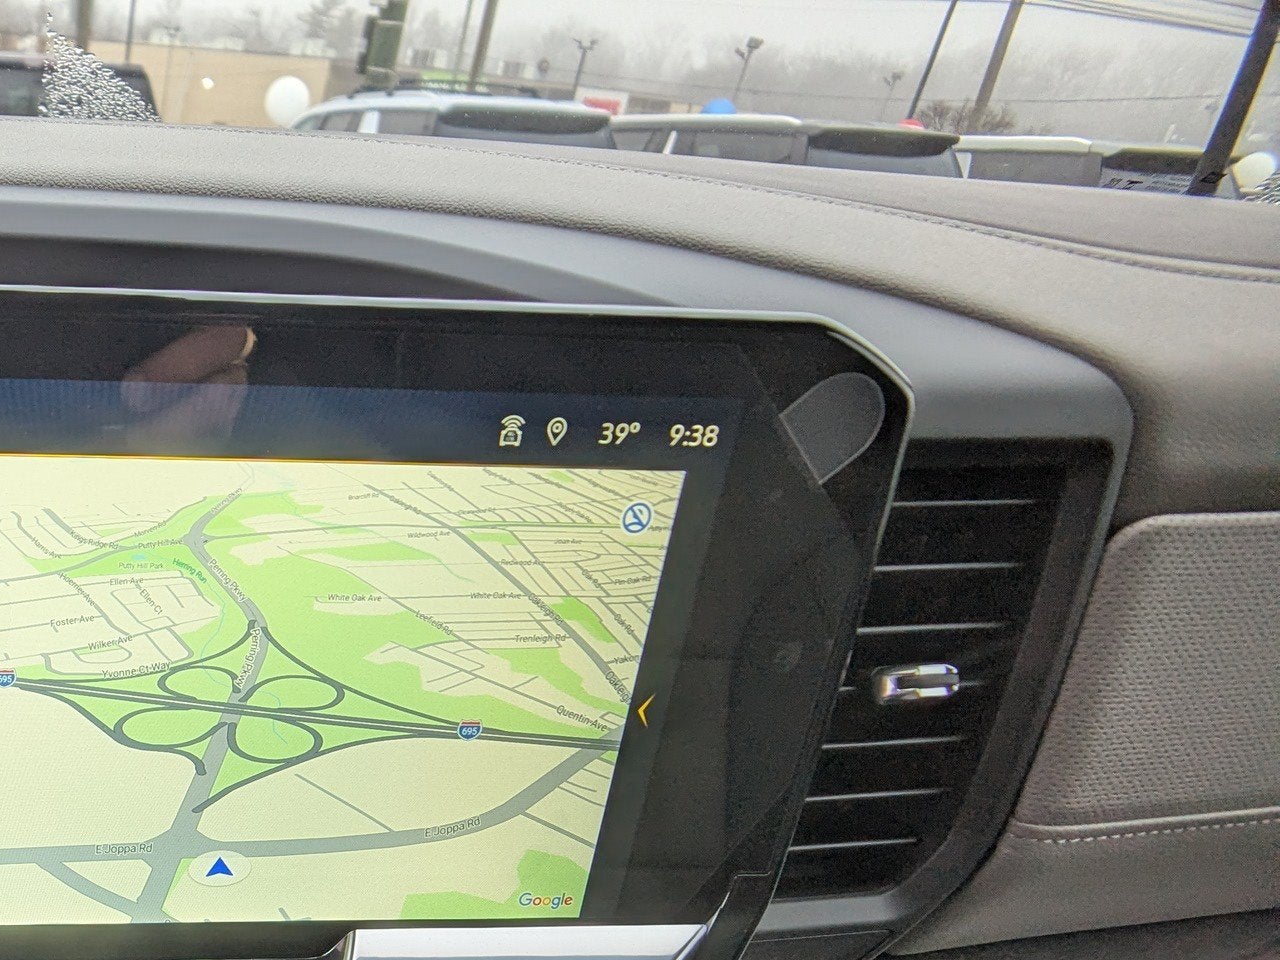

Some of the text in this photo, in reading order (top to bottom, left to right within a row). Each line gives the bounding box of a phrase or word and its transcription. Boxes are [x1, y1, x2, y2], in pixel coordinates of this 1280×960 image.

[669, 424, 720, 447] 9:38
[109, 578, 127, 586] Ellen
[192, 569, 208, 584] Run
[228, 580, 247, 602] Pkwy
[327, 593, 382, 602] White Oak Ave
[470, 591, 490, 600] White
[492, 591, 506, 599] Oak
[50, 615, 95, 628] Foster Ave
[88, 634, 133, 651] Wilker Ave
[514, 633, 567, 643] Trenleigh Rd
[234, 628, 261, 687] Perring Pkwy
[102, 662, 171, 679] Yvonne Ct Way
[556, 705, 608, 732] Quentin Ave
[461, 725, 479, 736] 695
[424, 817, 481, 838] E Joppa Rd
[95, 843, 153, 856] E Joppa Rd
[518, 893, 574, 910] Google
